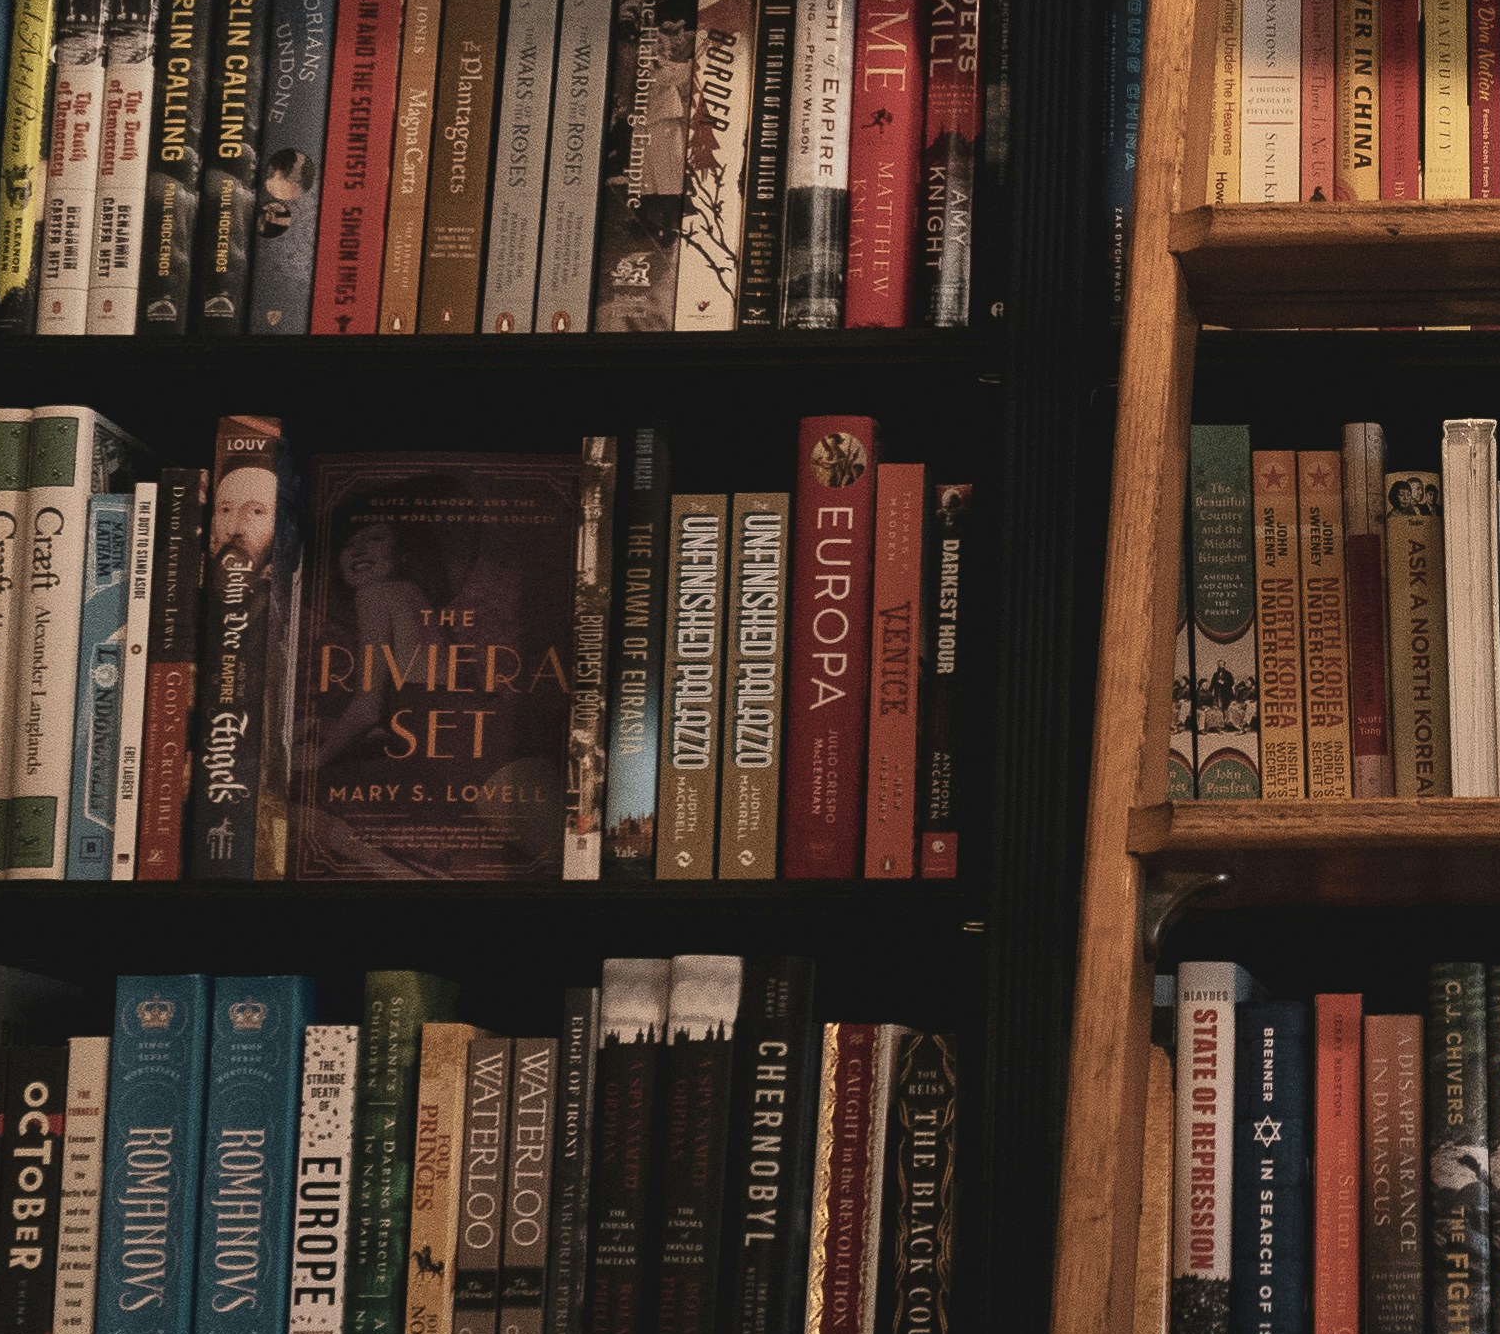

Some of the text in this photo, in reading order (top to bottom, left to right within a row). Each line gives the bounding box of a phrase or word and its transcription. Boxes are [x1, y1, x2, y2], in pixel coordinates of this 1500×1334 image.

[1352, 49, 1373, 75] IN
[1354, 81, 1373, 170] CHINA
[419, 610, 477, 627] THE
[672, 515, 720, 770] UNFINISHED PALAZZO
[809, 505, 855, 711] EUROPA
[318, 644, 573, 695] RIVIERA
[385, 711, 496, 760] SET
[463, 1049, 503, 1251] WATERLOO
[743, 1040, 789, 1248] CHERNOBYL
